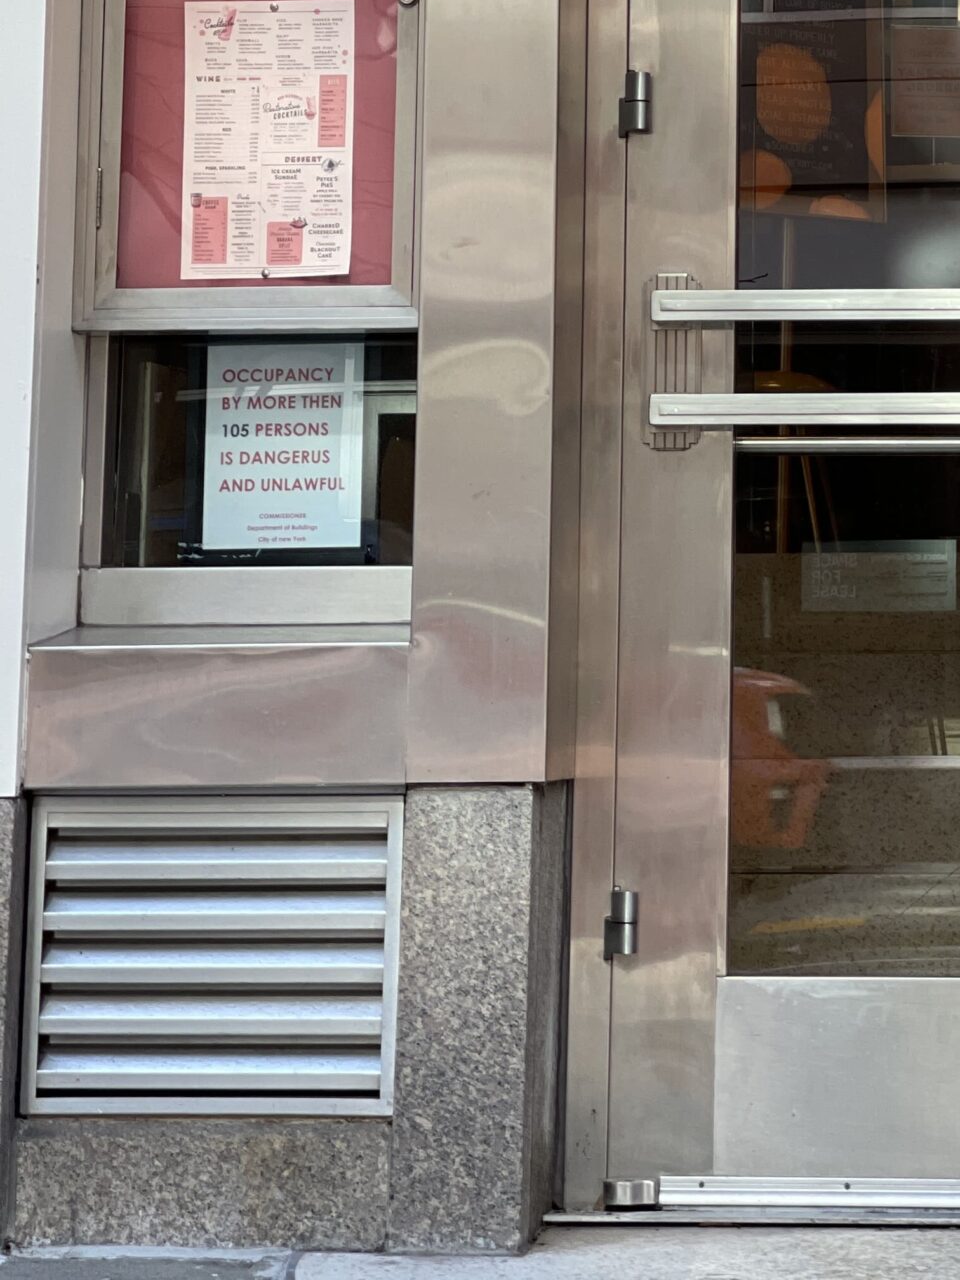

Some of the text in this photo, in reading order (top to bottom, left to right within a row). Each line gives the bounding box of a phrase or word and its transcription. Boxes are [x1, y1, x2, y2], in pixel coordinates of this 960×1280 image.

[222, 367, 335, 384] OCCUPANCY
[222, 395, 342, 410] BY MORE THEN
[222, 422, 329, 438] 105 PERSONS
[220, 450, 330, 466] IS DANGERUS
[219, 477, 345, 493] AND UNLAWFUL
